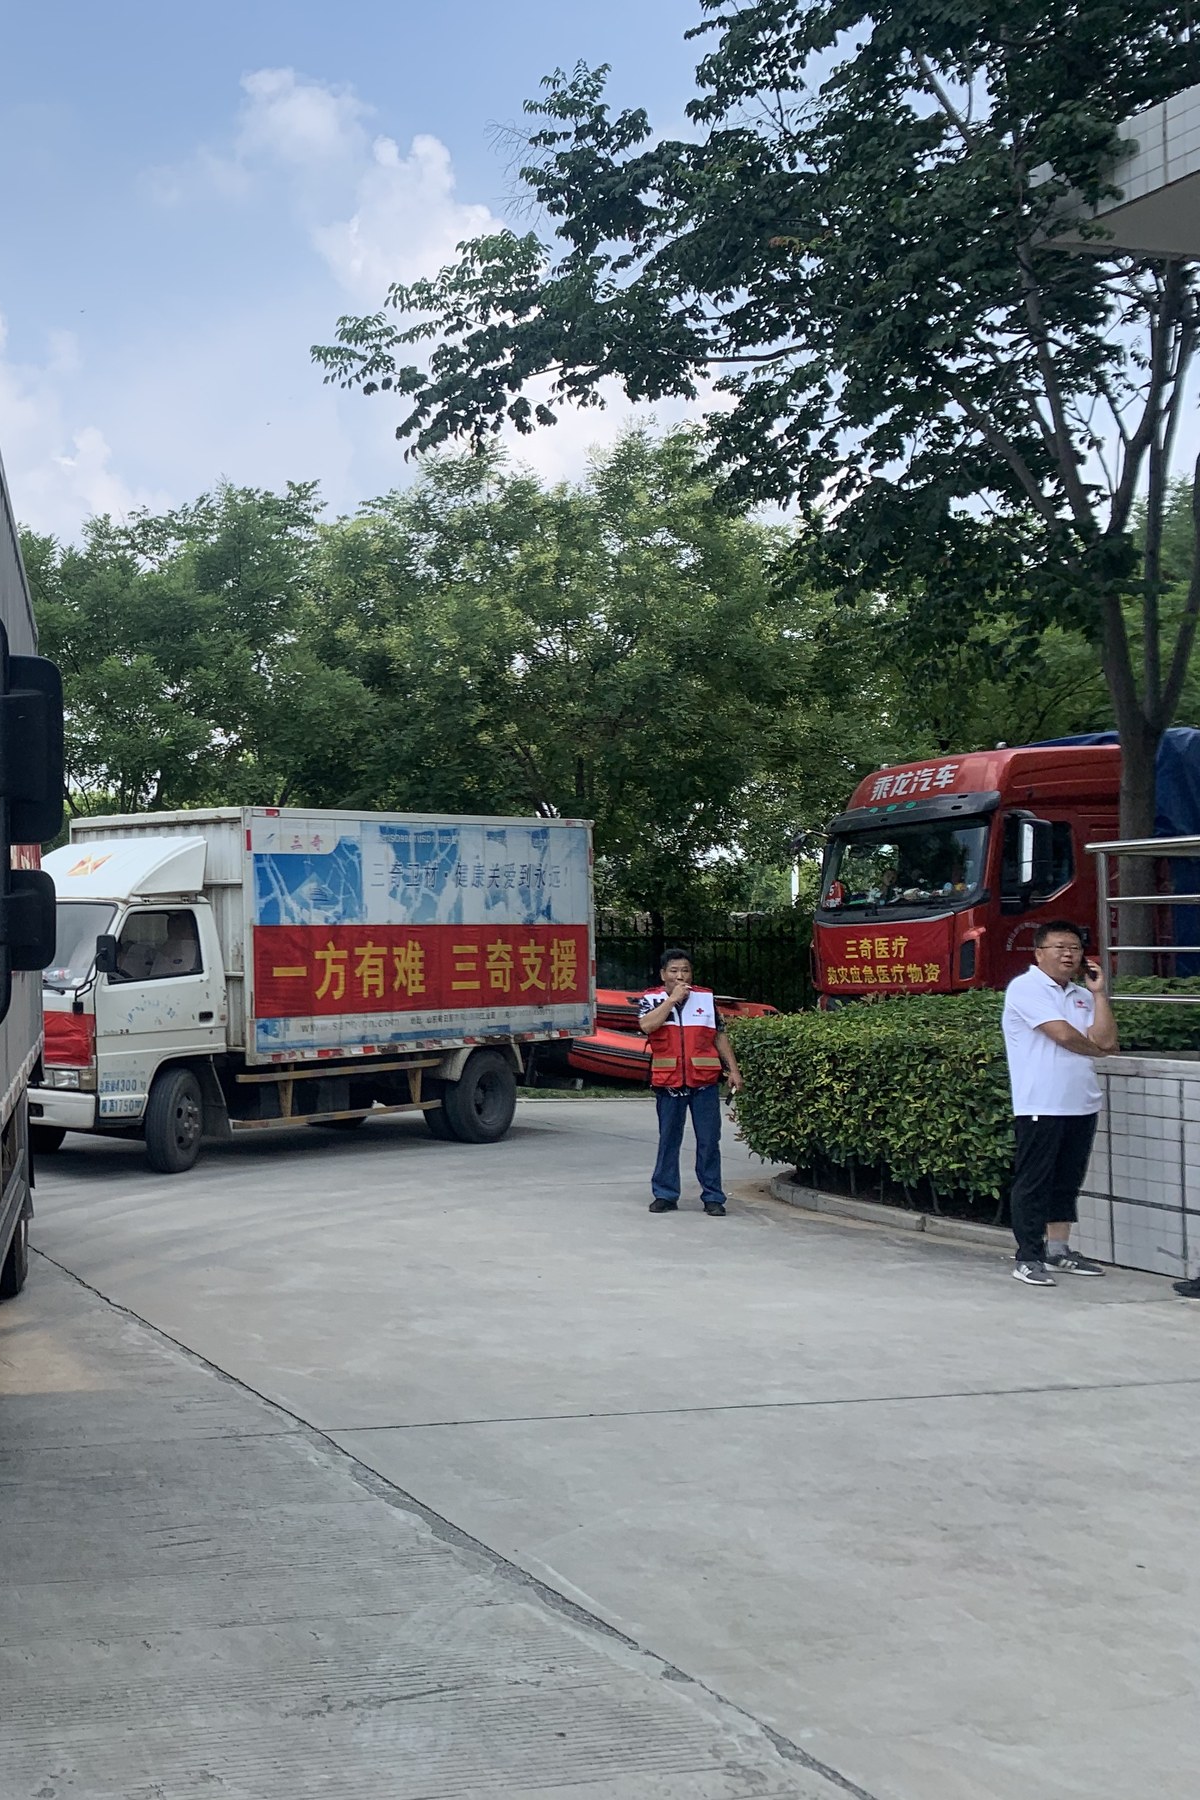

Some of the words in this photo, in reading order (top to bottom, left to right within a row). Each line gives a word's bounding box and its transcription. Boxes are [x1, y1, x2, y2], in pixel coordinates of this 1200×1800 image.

[871, 764, 959, 801] 乘龙汽车
[845, 935, 909, 960] 三奇医疗
[272, 940, 426, 1000] 一方有难
[451, 938, 578, 992] 三奇支援
[827, 963, 941, 985] 救灾应急医疗物资
